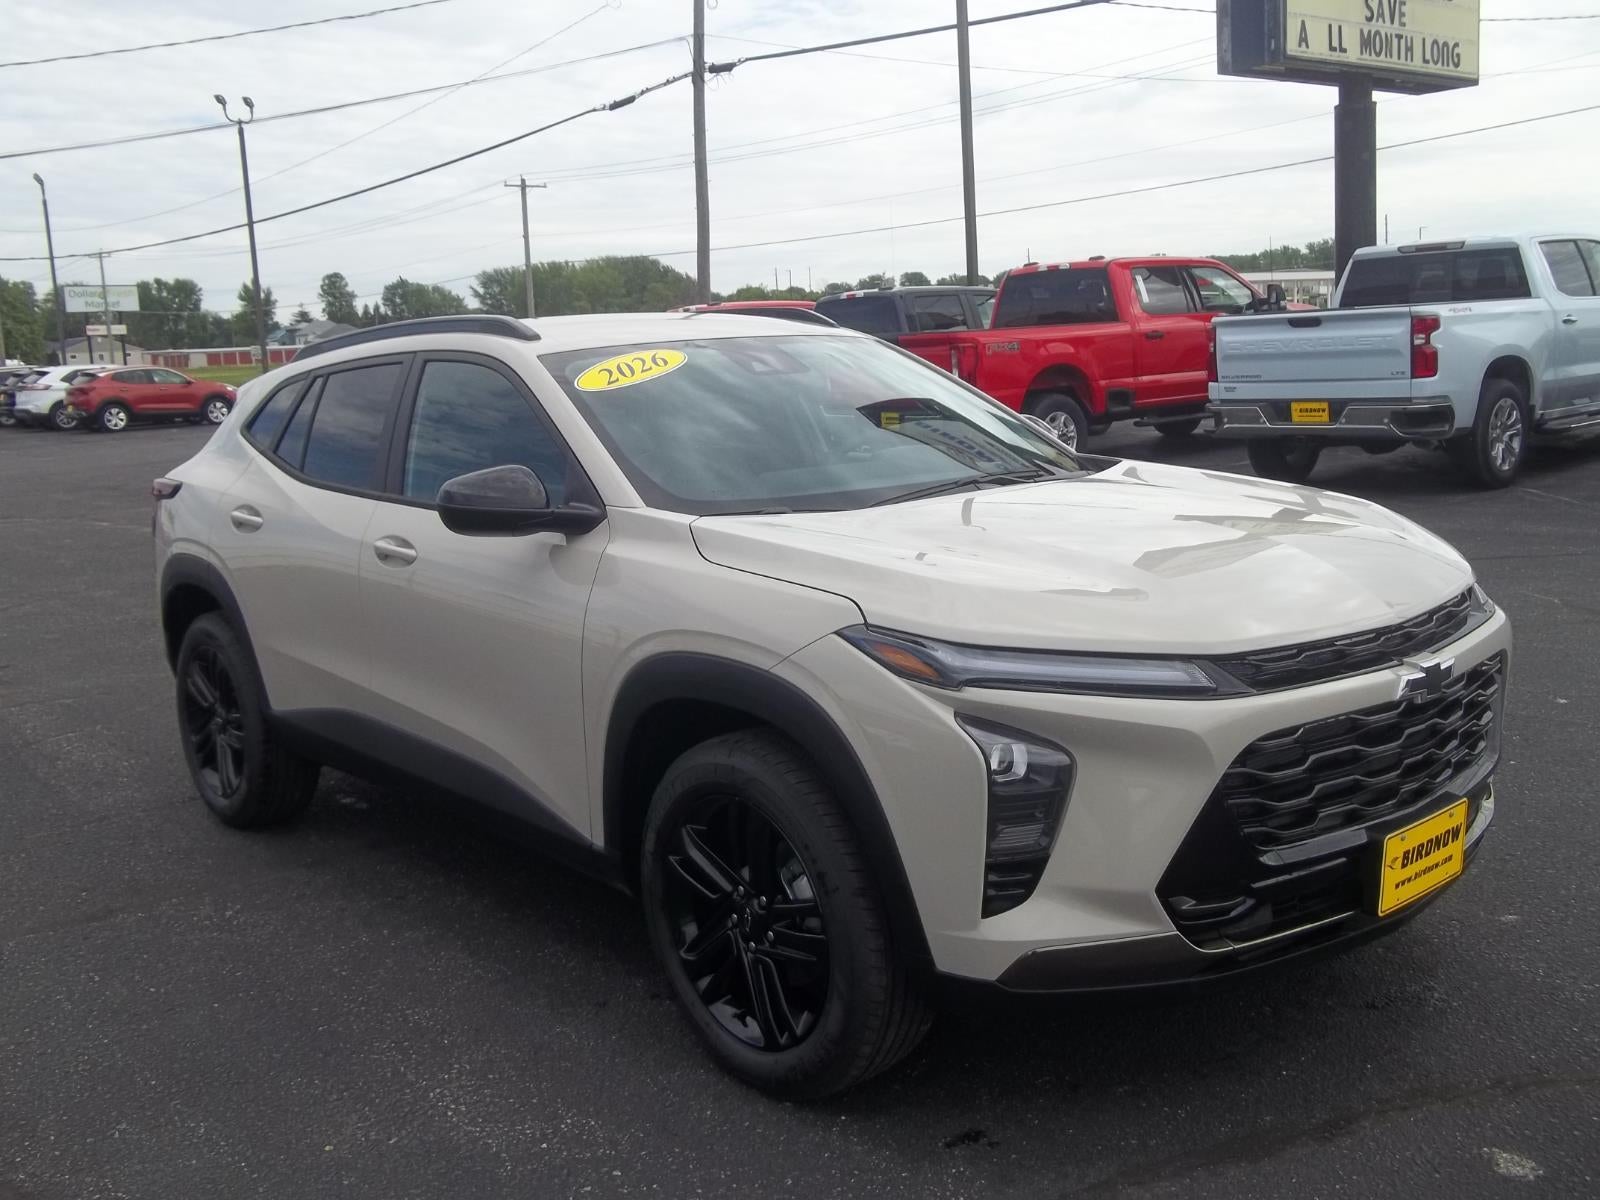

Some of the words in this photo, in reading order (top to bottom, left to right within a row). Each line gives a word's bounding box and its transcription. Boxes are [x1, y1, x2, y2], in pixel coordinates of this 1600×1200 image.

[1364, 0, 1407, 28] SAVE
[1359, 28, 1414, 63] MONTH
[1421, 37, 1461, 69] LONG
[1226, 335, 1393, 353] CHEVROLET
[598, 352, 668, 385] 2026
[1401, 823, 1462, 870] BIRDNOW
[1395, 854, 1453, 890] www.birdnow.com
